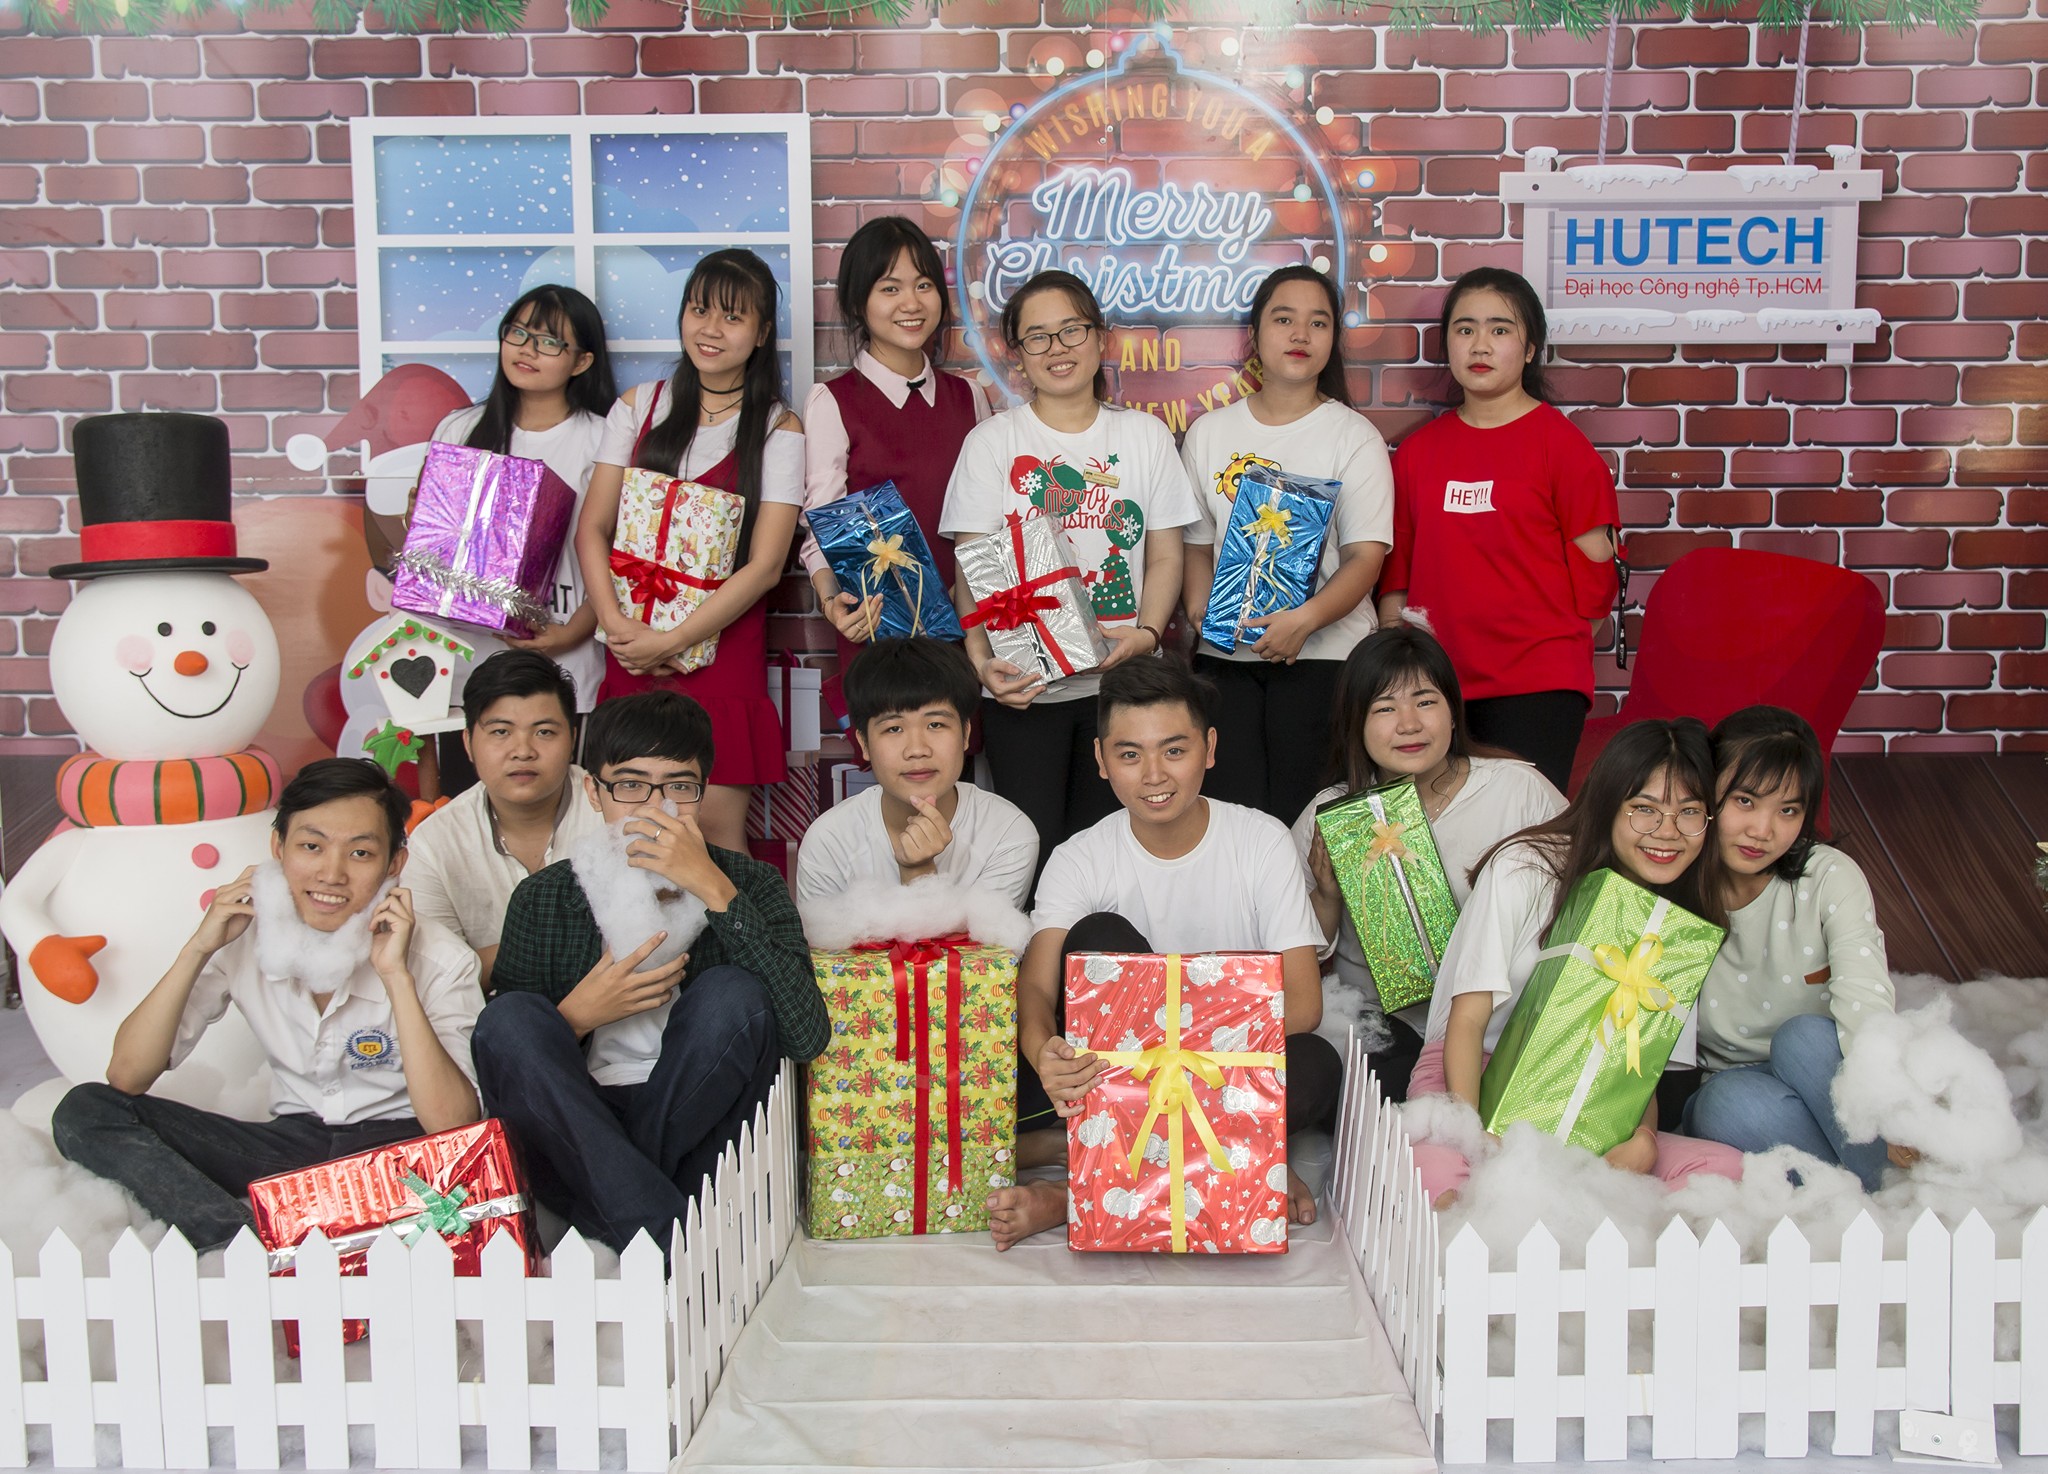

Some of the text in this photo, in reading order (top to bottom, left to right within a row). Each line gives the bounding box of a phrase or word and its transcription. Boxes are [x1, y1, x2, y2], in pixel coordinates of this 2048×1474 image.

[1024, 83, 1275, 162] WISHING YOU A
[1032, 166, 1273, 264] Merry
[1566, 216, 1824, 266] HUTECH
[1564, 277, 1822, 298] Đại học Công nghệ Tp.HCM
[1120, 338, 1181, 372] AND
[1044, 486, 1110, 515] Merry
[1450, 488, 1488, 506] HEY!!
